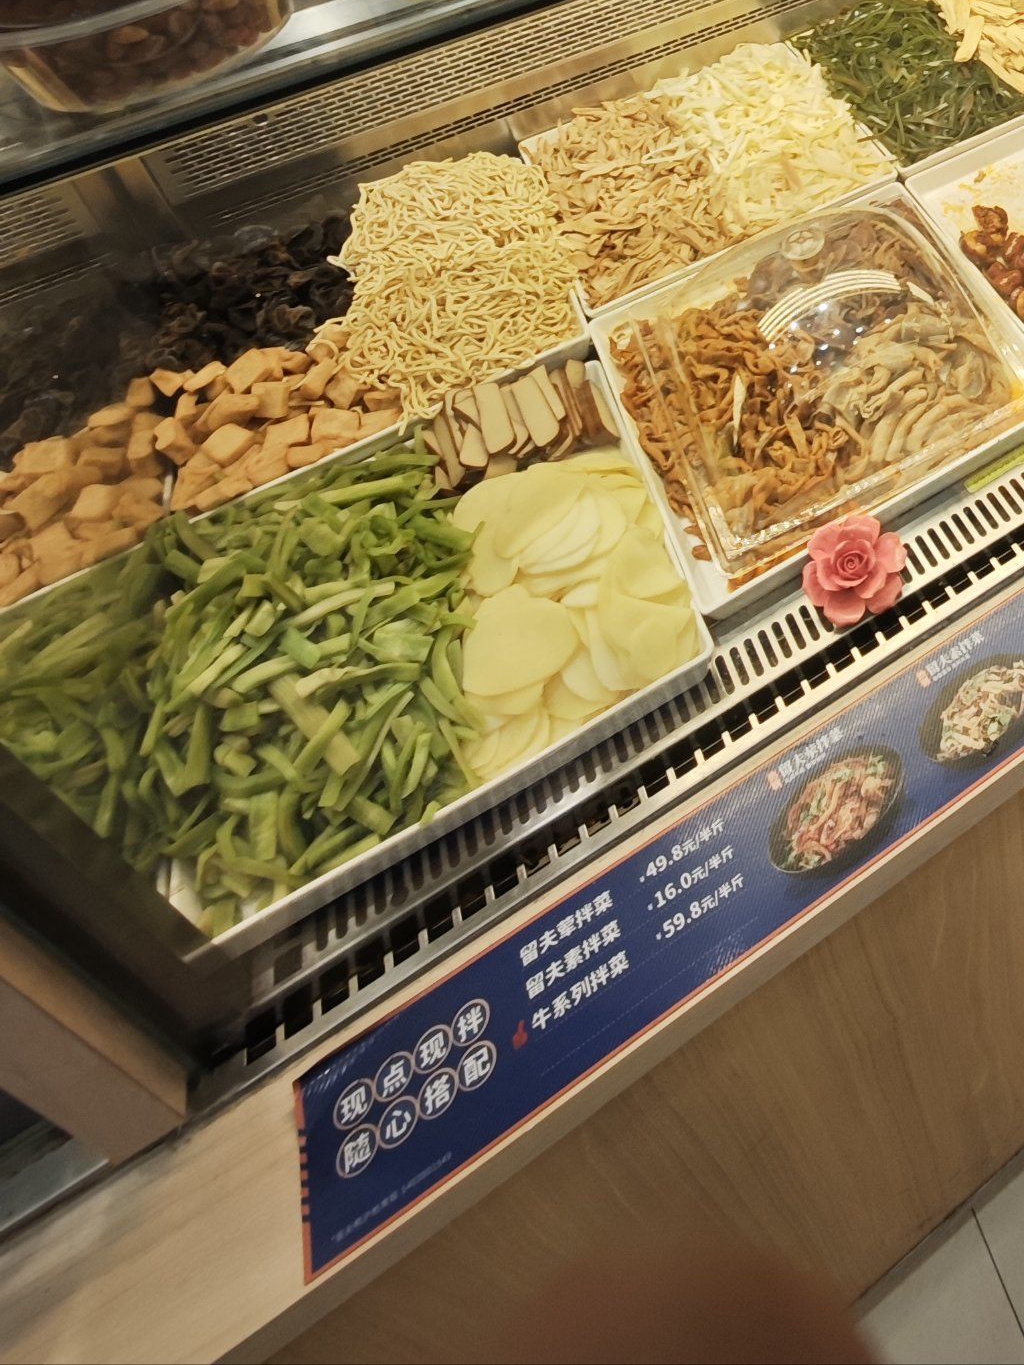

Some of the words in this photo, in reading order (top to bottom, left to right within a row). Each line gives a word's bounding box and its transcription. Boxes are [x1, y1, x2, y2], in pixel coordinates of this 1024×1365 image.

[520, 890, 613, 966] 留夫荤拌菜
[525, 920, 621, 999] 留夫素拌菜
[532, 950, 629, 1029] 牛系列拌菜
[338, 1003, 485, 1125] 现点现拌
[343, 1044, 491, 1175] 随心搭配
